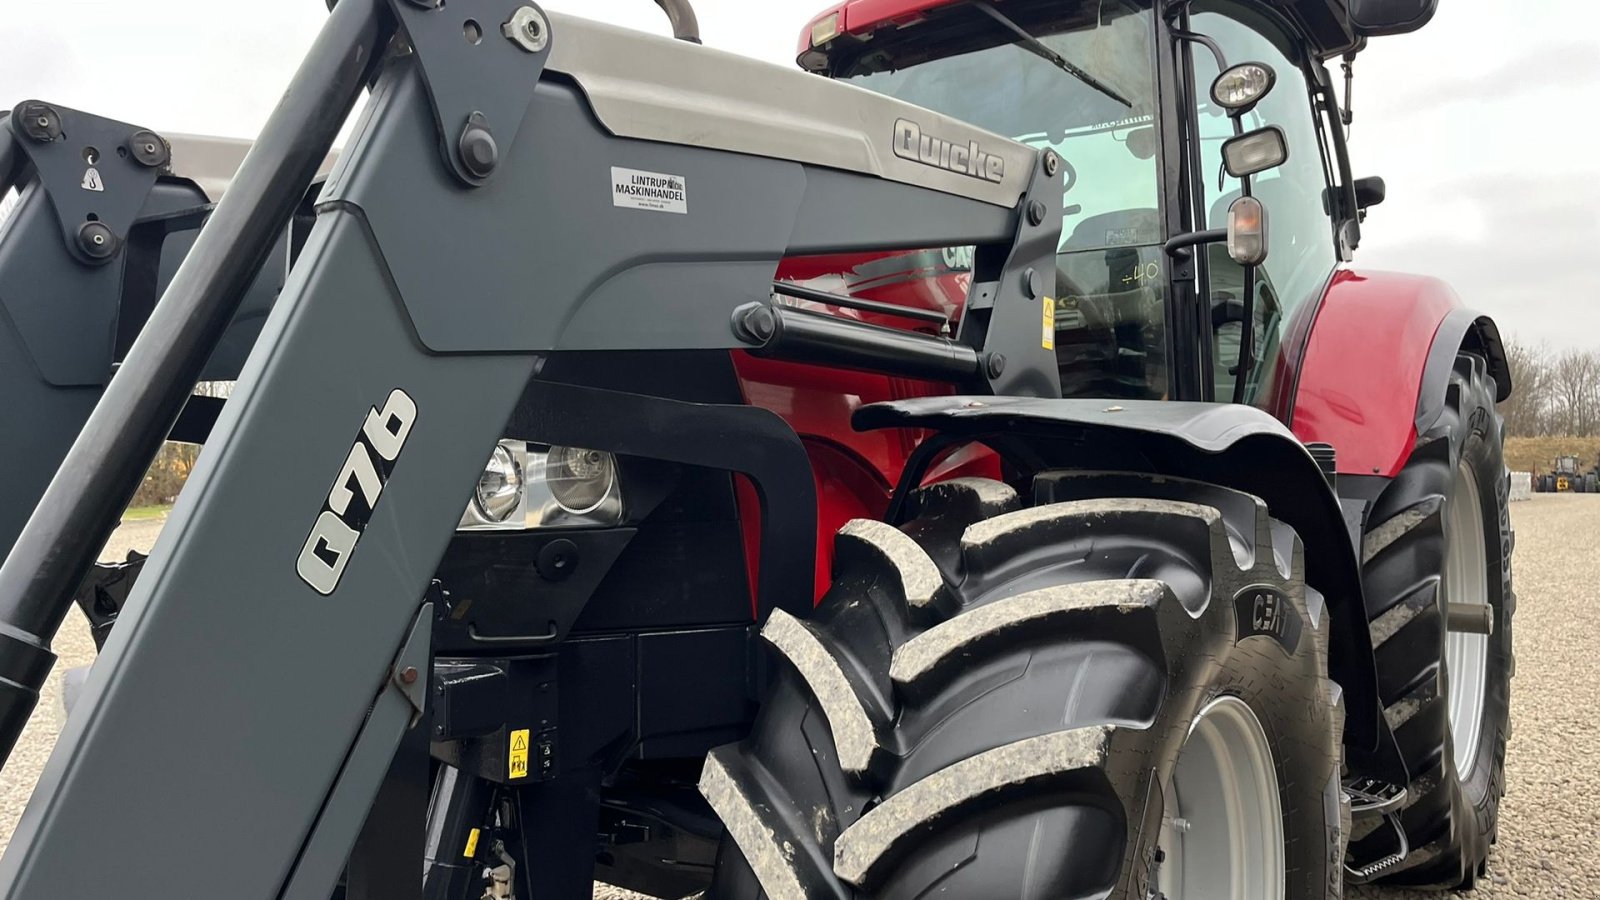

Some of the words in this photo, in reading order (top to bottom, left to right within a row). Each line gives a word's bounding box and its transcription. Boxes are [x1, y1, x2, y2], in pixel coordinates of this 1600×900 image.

[893, 117, 1004, 184] Quicke
[615, 183, 684, 201] MASKINHANDEL
[631, 174, 667, 189] LINTRUP
[296, 388, 418, 596] Q76
[1252, 594, 1290, 638] CEAT
